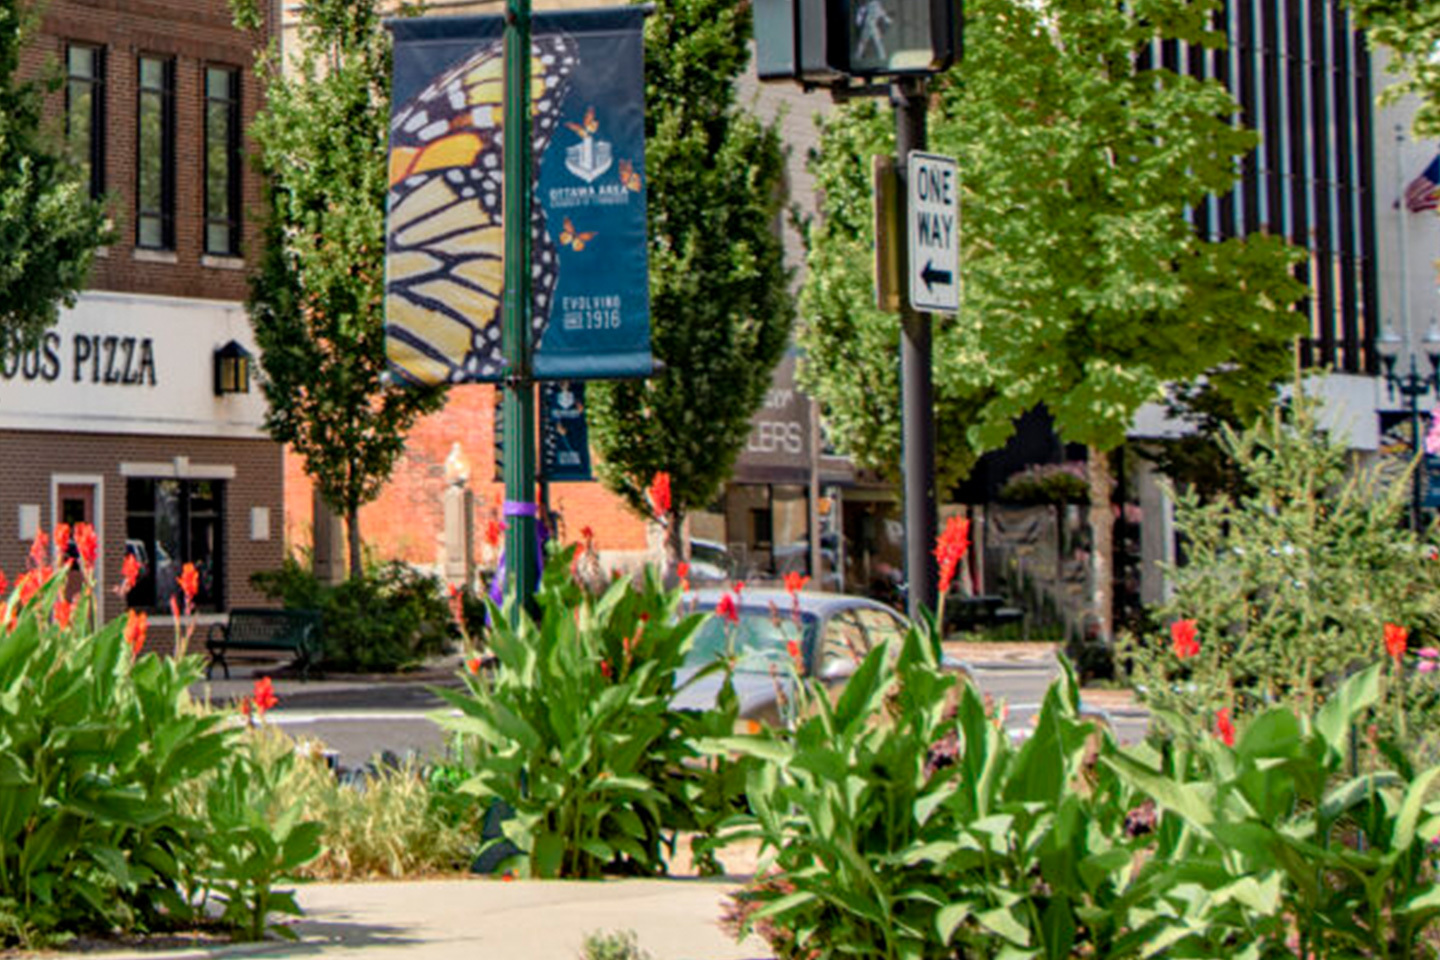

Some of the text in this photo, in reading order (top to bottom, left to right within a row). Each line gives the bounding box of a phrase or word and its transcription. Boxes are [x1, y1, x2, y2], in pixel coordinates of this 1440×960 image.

[917, 166, 951, 205] ONE
[917, 212, 953, 250] WAY
[562, 295, 621, 310] EVOLVING
[586, 309, 621, 330] 1916
[2, 331, 157, 387] OUS PIZZA
[747, 420, 803, 454] LERS
